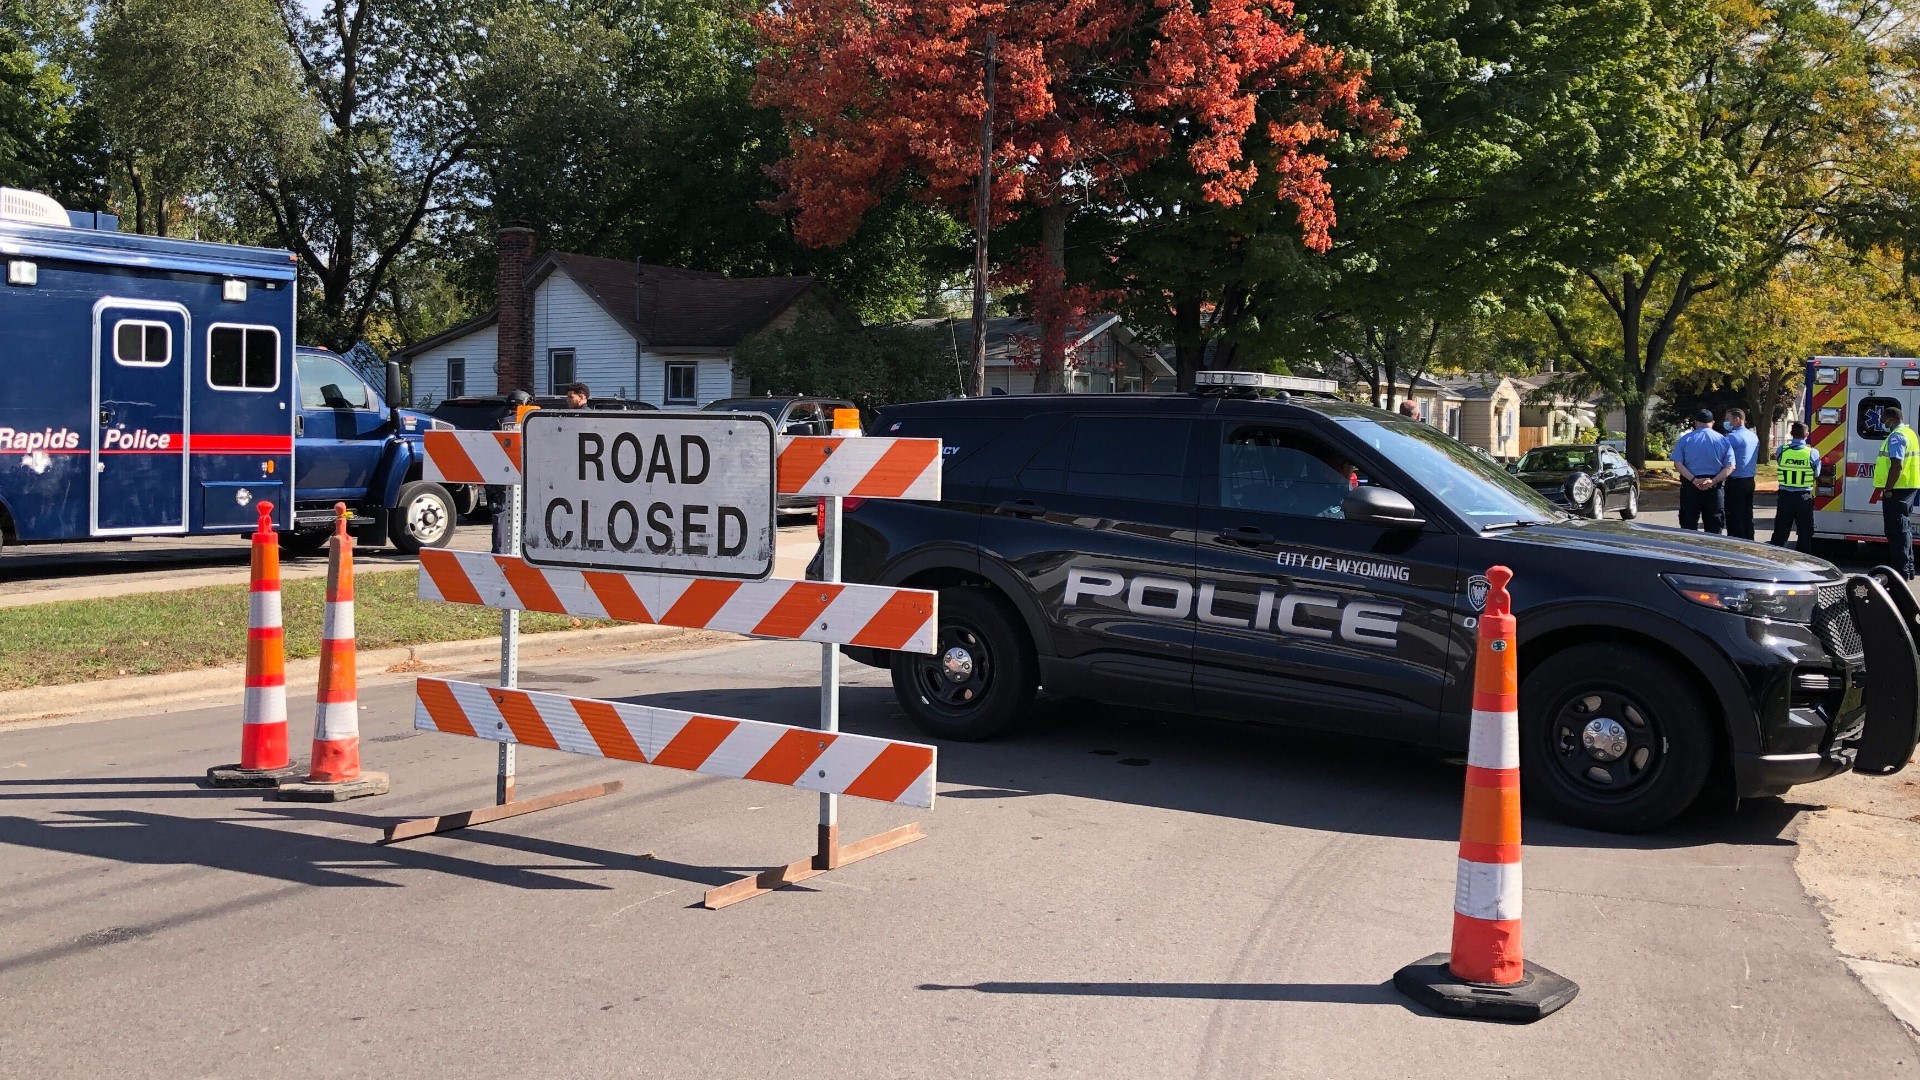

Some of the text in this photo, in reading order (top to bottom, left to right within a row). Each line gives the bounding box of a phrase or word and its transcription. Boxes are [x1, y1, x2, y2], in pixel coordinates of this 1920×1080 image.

[0, 427, 170, 453] Rapids Police
[578, 432, 711, 485] ROAD
[941, 446, 961, 455] CY
[544, 497, 748, 556] CLOSED
[1277, 551, 1411, 581] CITY OF WYOMING
[1063, 566, 1404, 648] POLICE
